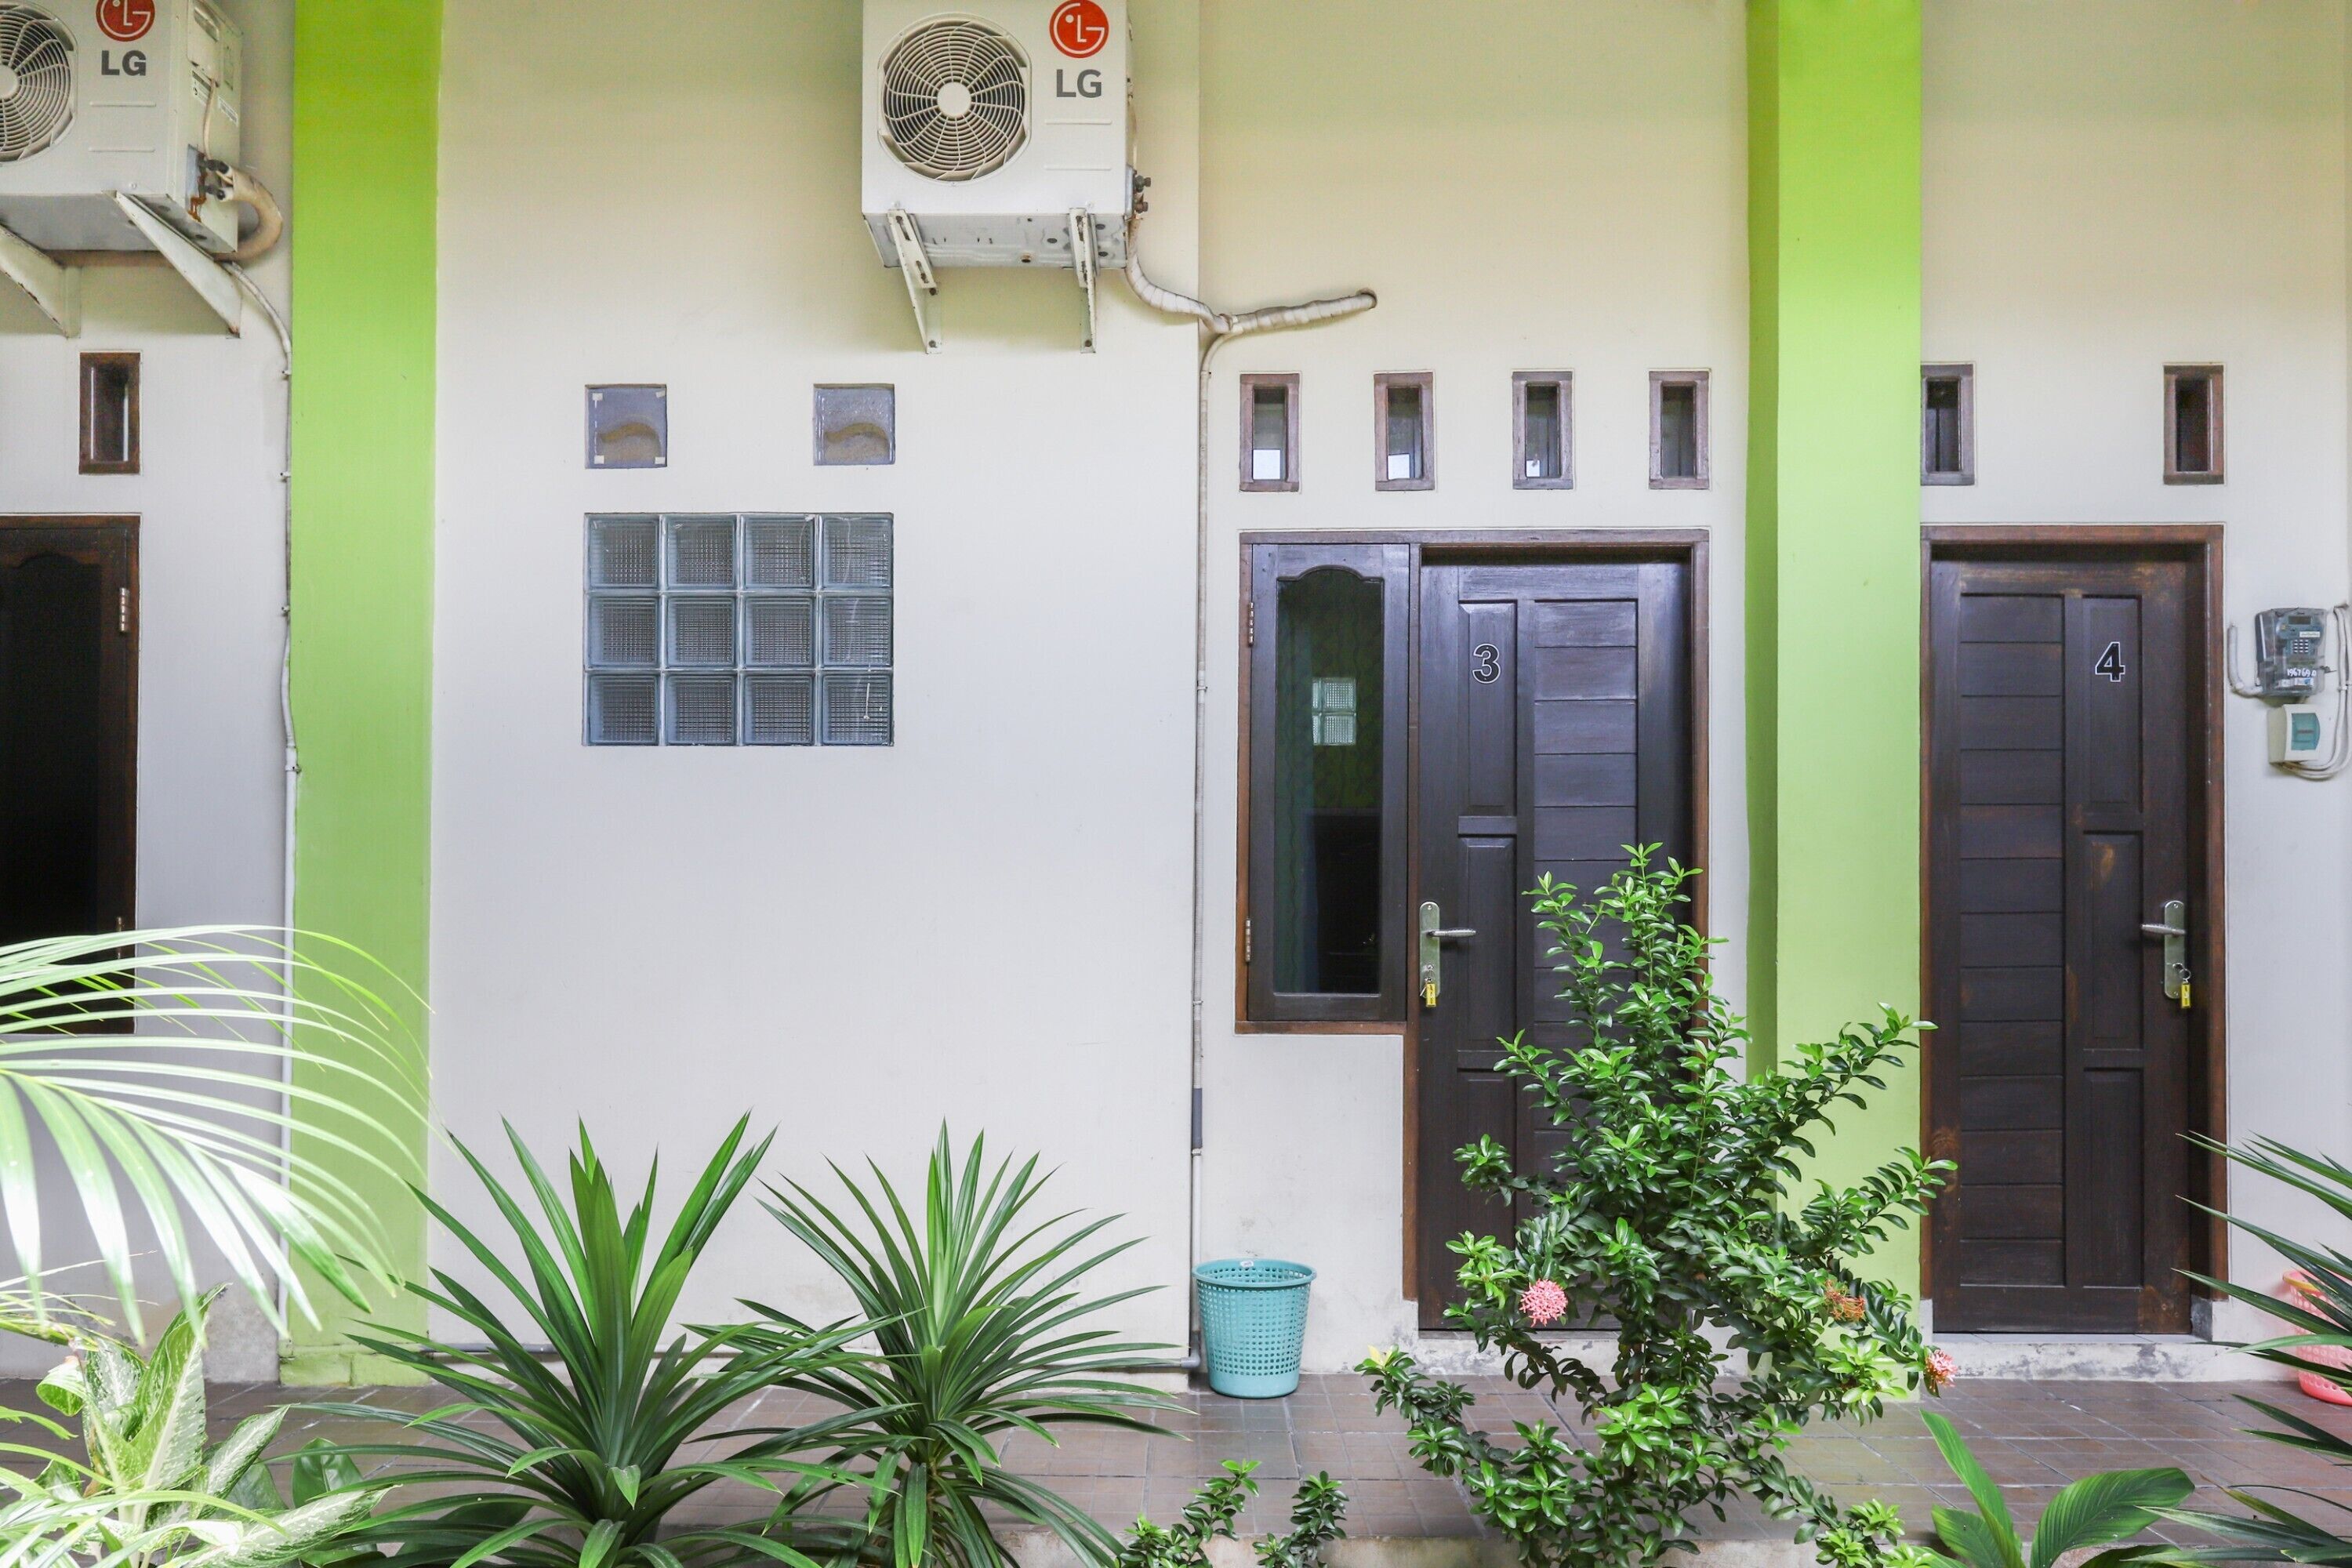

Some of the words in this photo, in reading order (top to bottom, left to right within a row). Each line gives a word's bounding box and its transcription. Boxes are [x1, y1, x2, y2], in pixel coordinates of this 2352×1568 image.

[101, 49, 147, 76] LG
[1056, 69, 1102, 98] LG
[1472, 643, 1501, 684] 3
[2095, 641, 2125, 682] 4
